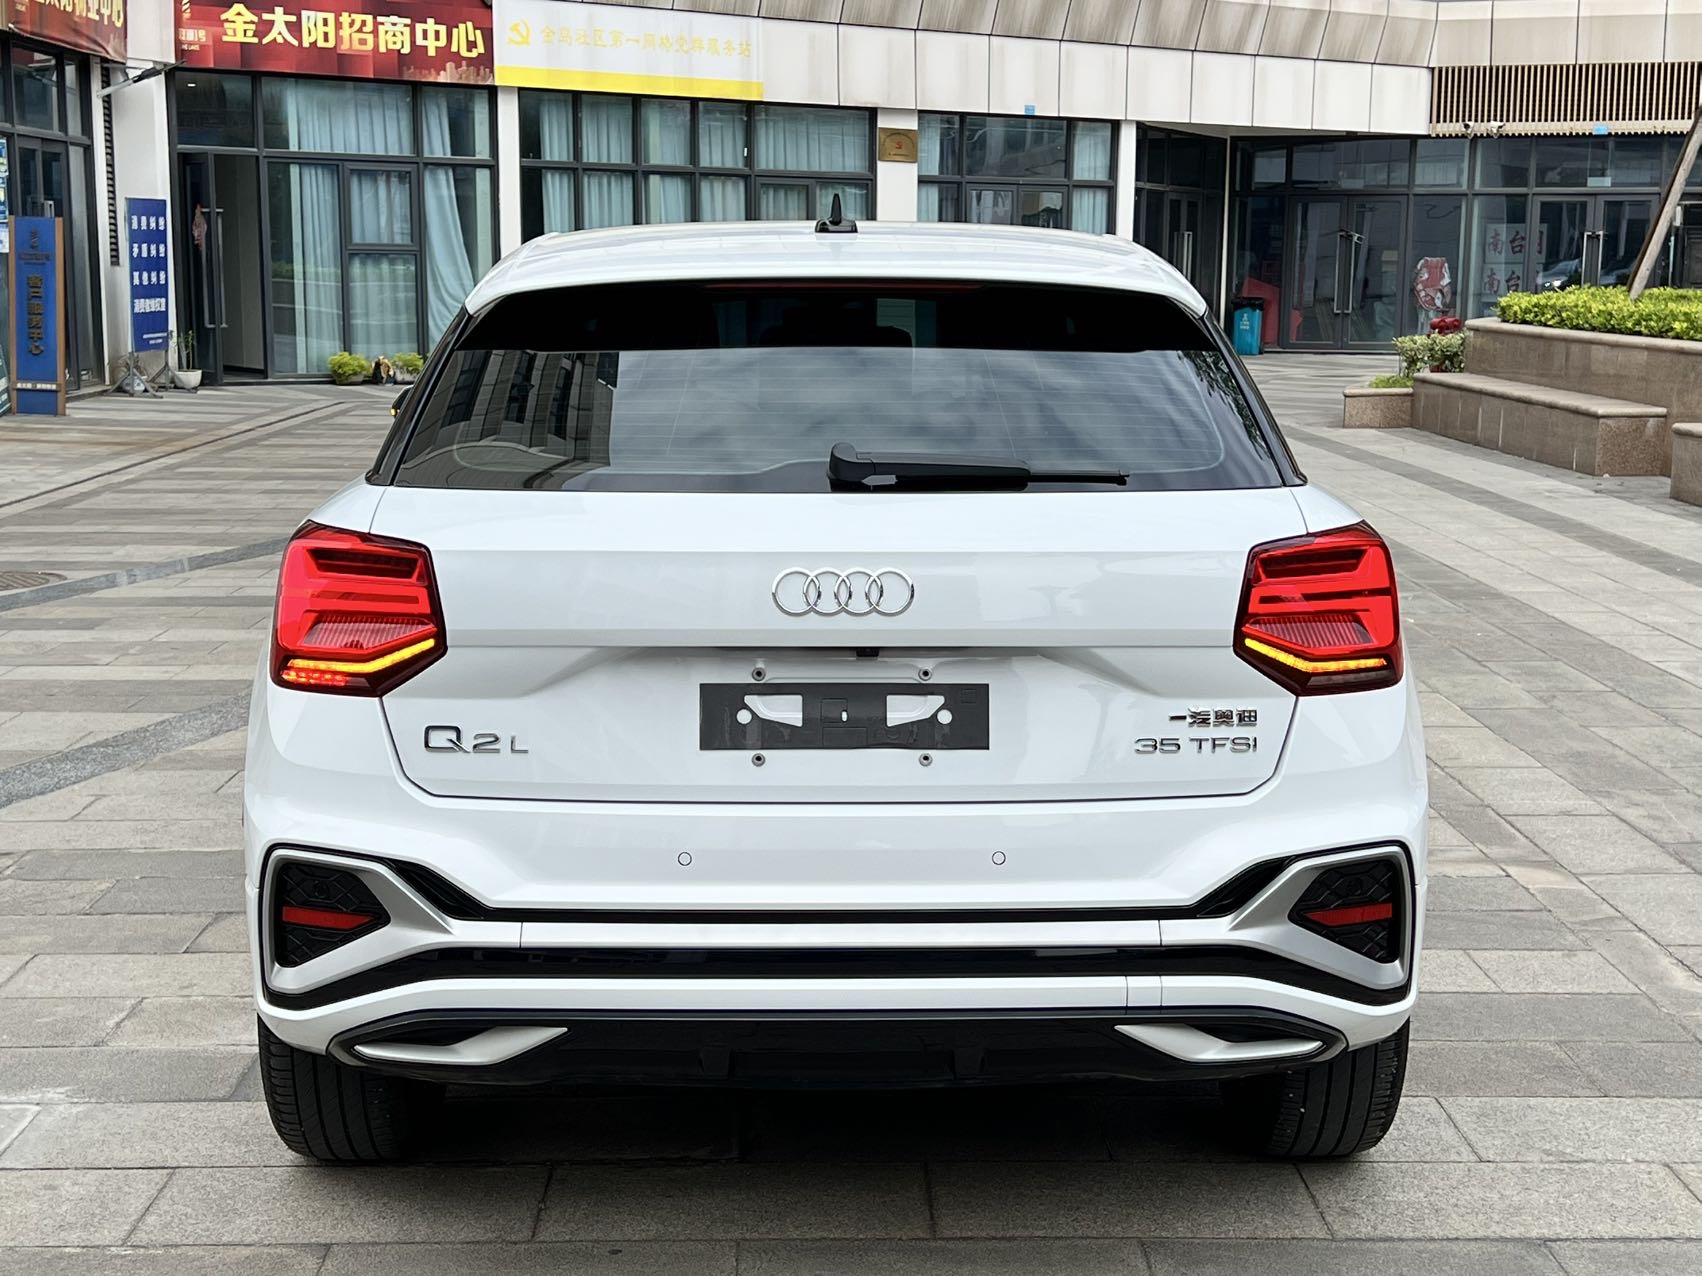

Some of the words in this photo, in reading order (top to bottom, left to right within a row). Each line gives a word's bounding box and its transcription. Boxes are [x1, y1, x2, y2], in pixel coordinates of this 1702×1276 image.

[220, 3, 485, 58] 金太阳招商中心
[1168, 708, 1258, 728] 一汽奥迪
[1134, 737, 1181, 754] 35
